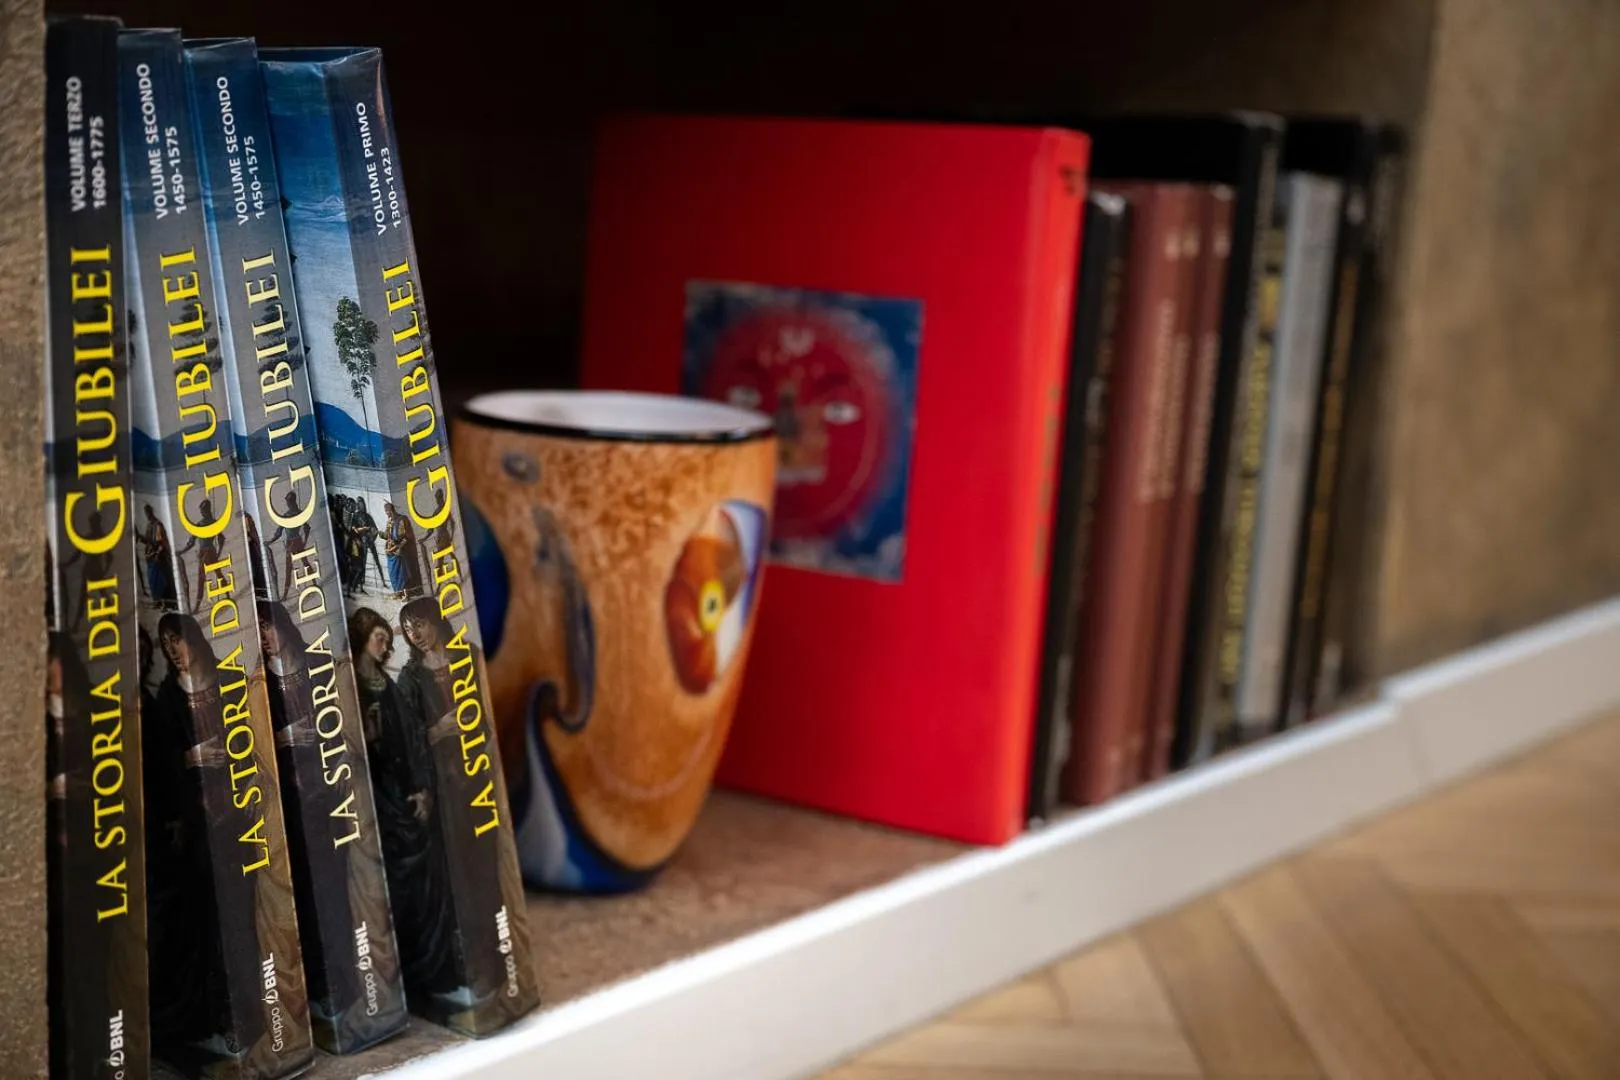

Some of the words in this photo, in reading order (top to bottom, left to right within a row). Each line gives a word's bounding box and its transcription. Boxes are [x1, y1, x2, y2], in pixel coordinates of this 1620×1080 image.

[65, 77, 82, 132] TERZO
[136, 63, 159, 144] SECONDO
[216, 77, 238, 153] SECONDO
[356, 102, 374, 158] PRIMO
[70, 137, 87, 212] VOLUME
[89, 116, 107, 208] 1600-1775
[148, 148, 168, 220] VOLUME
[165, 127, 186, 214] 1450-1575
[229, 157, 248, 226] VOLUME
[244, 136, 264, 219] 1450-1575
[367, 164, 387, 236] VOLUME
[380, 147, 401, 228] 1300-1423
[64, 244, 126, 555] GIUBILEI
[159, 246, 233, 539] GIUBILEI
[242, 249, 316, 528] GIUBILEI
[382, 257, 452, 529] GIUBILEI
[87, 575, 120, 660] DEI
[203, 553, 240, 637] DEI
[291, 544, 326, 622] DEI
[432, 543, 464, 620] DEI
[217, 644, 262, 809] STORIA
[305, 626, 352, 785] STORIA
[446, 624, 491, 777] STORIA
[90, 669, 126, 850] STORIA
[239, 816, 270, 876] LA
[330, 790, 361, 849] LA
[470, 780, 500, 838] LA
[97, 859, 128, 922] LA
[495, 905, 509, 939] BNL
[263, 953, 277, 988] BNL
[356, 921, 370, 954] BNL
[365, 972, 377, 1017] Gruppo
[506, 956, 517, 997] Gruppo
[110, 1009, 124, 1052] BNL
[271, 1006, 283, 1053] Gruppo
